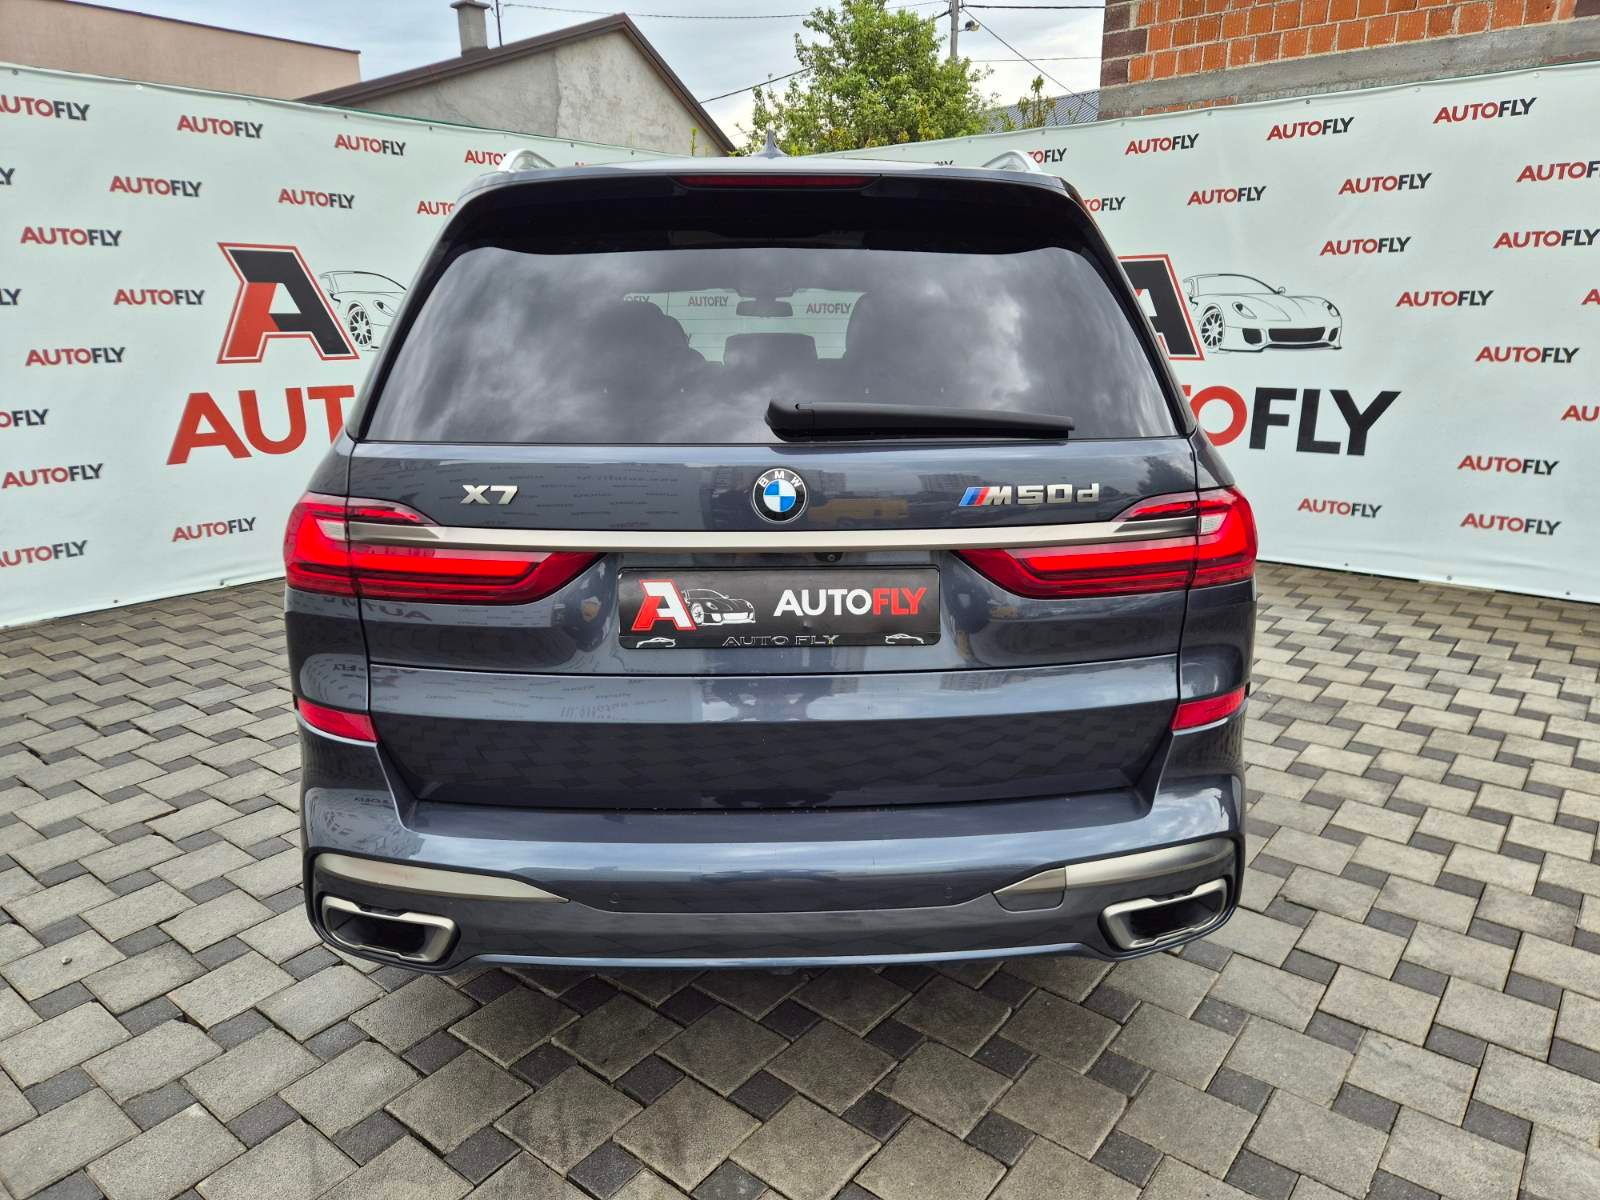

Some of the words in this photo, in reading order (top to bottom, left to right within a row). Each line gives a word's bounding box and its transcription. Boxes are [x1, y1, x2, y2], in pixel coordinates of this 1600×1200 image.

[0, 95, 90, 121] UTOFLY
[1433, 97, 1537, 124] AUTOFLY
[177, 115, 263, 139] AUTOFLY
[1266, 117, 1354, 141] AUTOFLY
[335, 135, 406, 156] AUTOFLY
[1125, 133, 1199, 155] AUTOFLY
[464, 150, 506, 165] AUTO
[1516, 161, 1600, 182] AUTOF
[110, 176, 202, 197] AUTOFLY
[1338, 173, 1432, 195] AUTOFLY
[278, 189, 355, 209] AUTOFLY
[1187, 186, 1266, 205] AUTOFLY
[21, 227, 122, 246] AUTOFLY
[1320, 237, 1411, 256] AUTOFLY
[1493, 229, 1600, 248] AUTOFLY
[114, 289, 205, 305] AUTOFLY
[687, 295, 729, 307] AUTOFLY
[1396, 290, 1494, 307] AUTOFLY
[806, 303, 851, 314] AUTOFLY
[26, 347, 125, 366] AUTOFLY
[1475, 347, 1579, 363] AUTOFLY
[1178, 384, 1402, 456] OFLY
[1457, 455, 1560, 475] AUTOFLY
[2, 463, 103, 488] AUTOFLY
[758, 470, 802, 488] BMW
[460, 484, 519, 505] X7
[1298, 499, 1382, 518] AUTOFLY
[172, 517, 256, 542] AUTOFLY
[1461, 513, 1561, 535] AUTOFLY
[773, 586, 928, 618] AUTOFLY
[722, 635, 789, 647] AUTO
[795, 635, 840, 646] FLY
